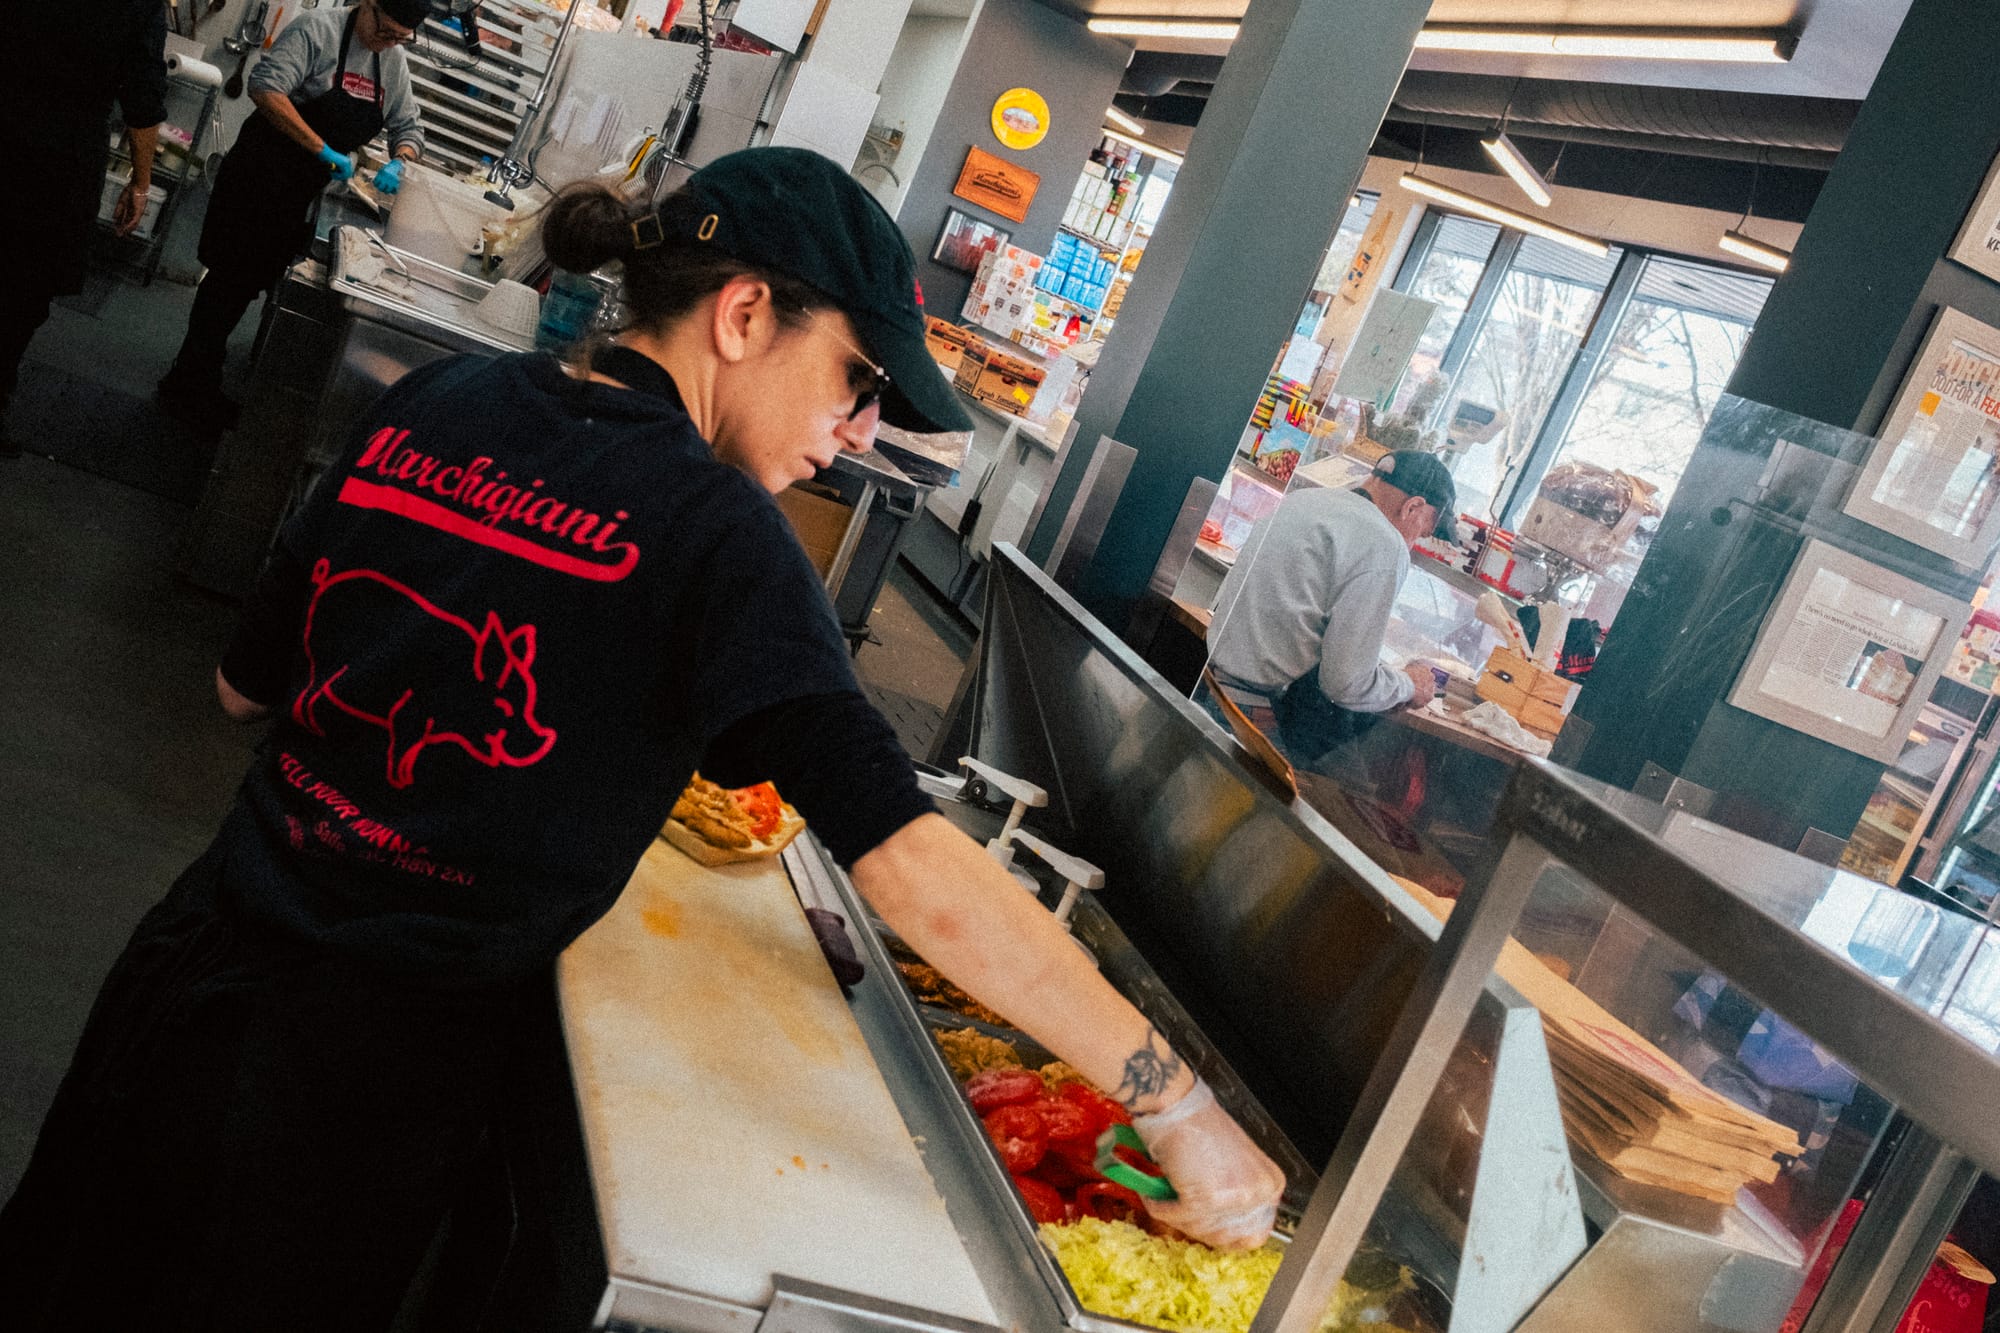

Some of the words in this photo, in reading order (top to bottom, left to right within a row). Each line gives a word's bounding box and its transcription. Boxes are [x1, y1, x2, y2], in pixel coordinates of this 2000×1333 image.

[1950, 383, 1974, 404] FOR
[1971, 391, 1982, 409] A
[356, 426, 633, 552] Marchigiani
[305, 781, 361, 820] YOUR
